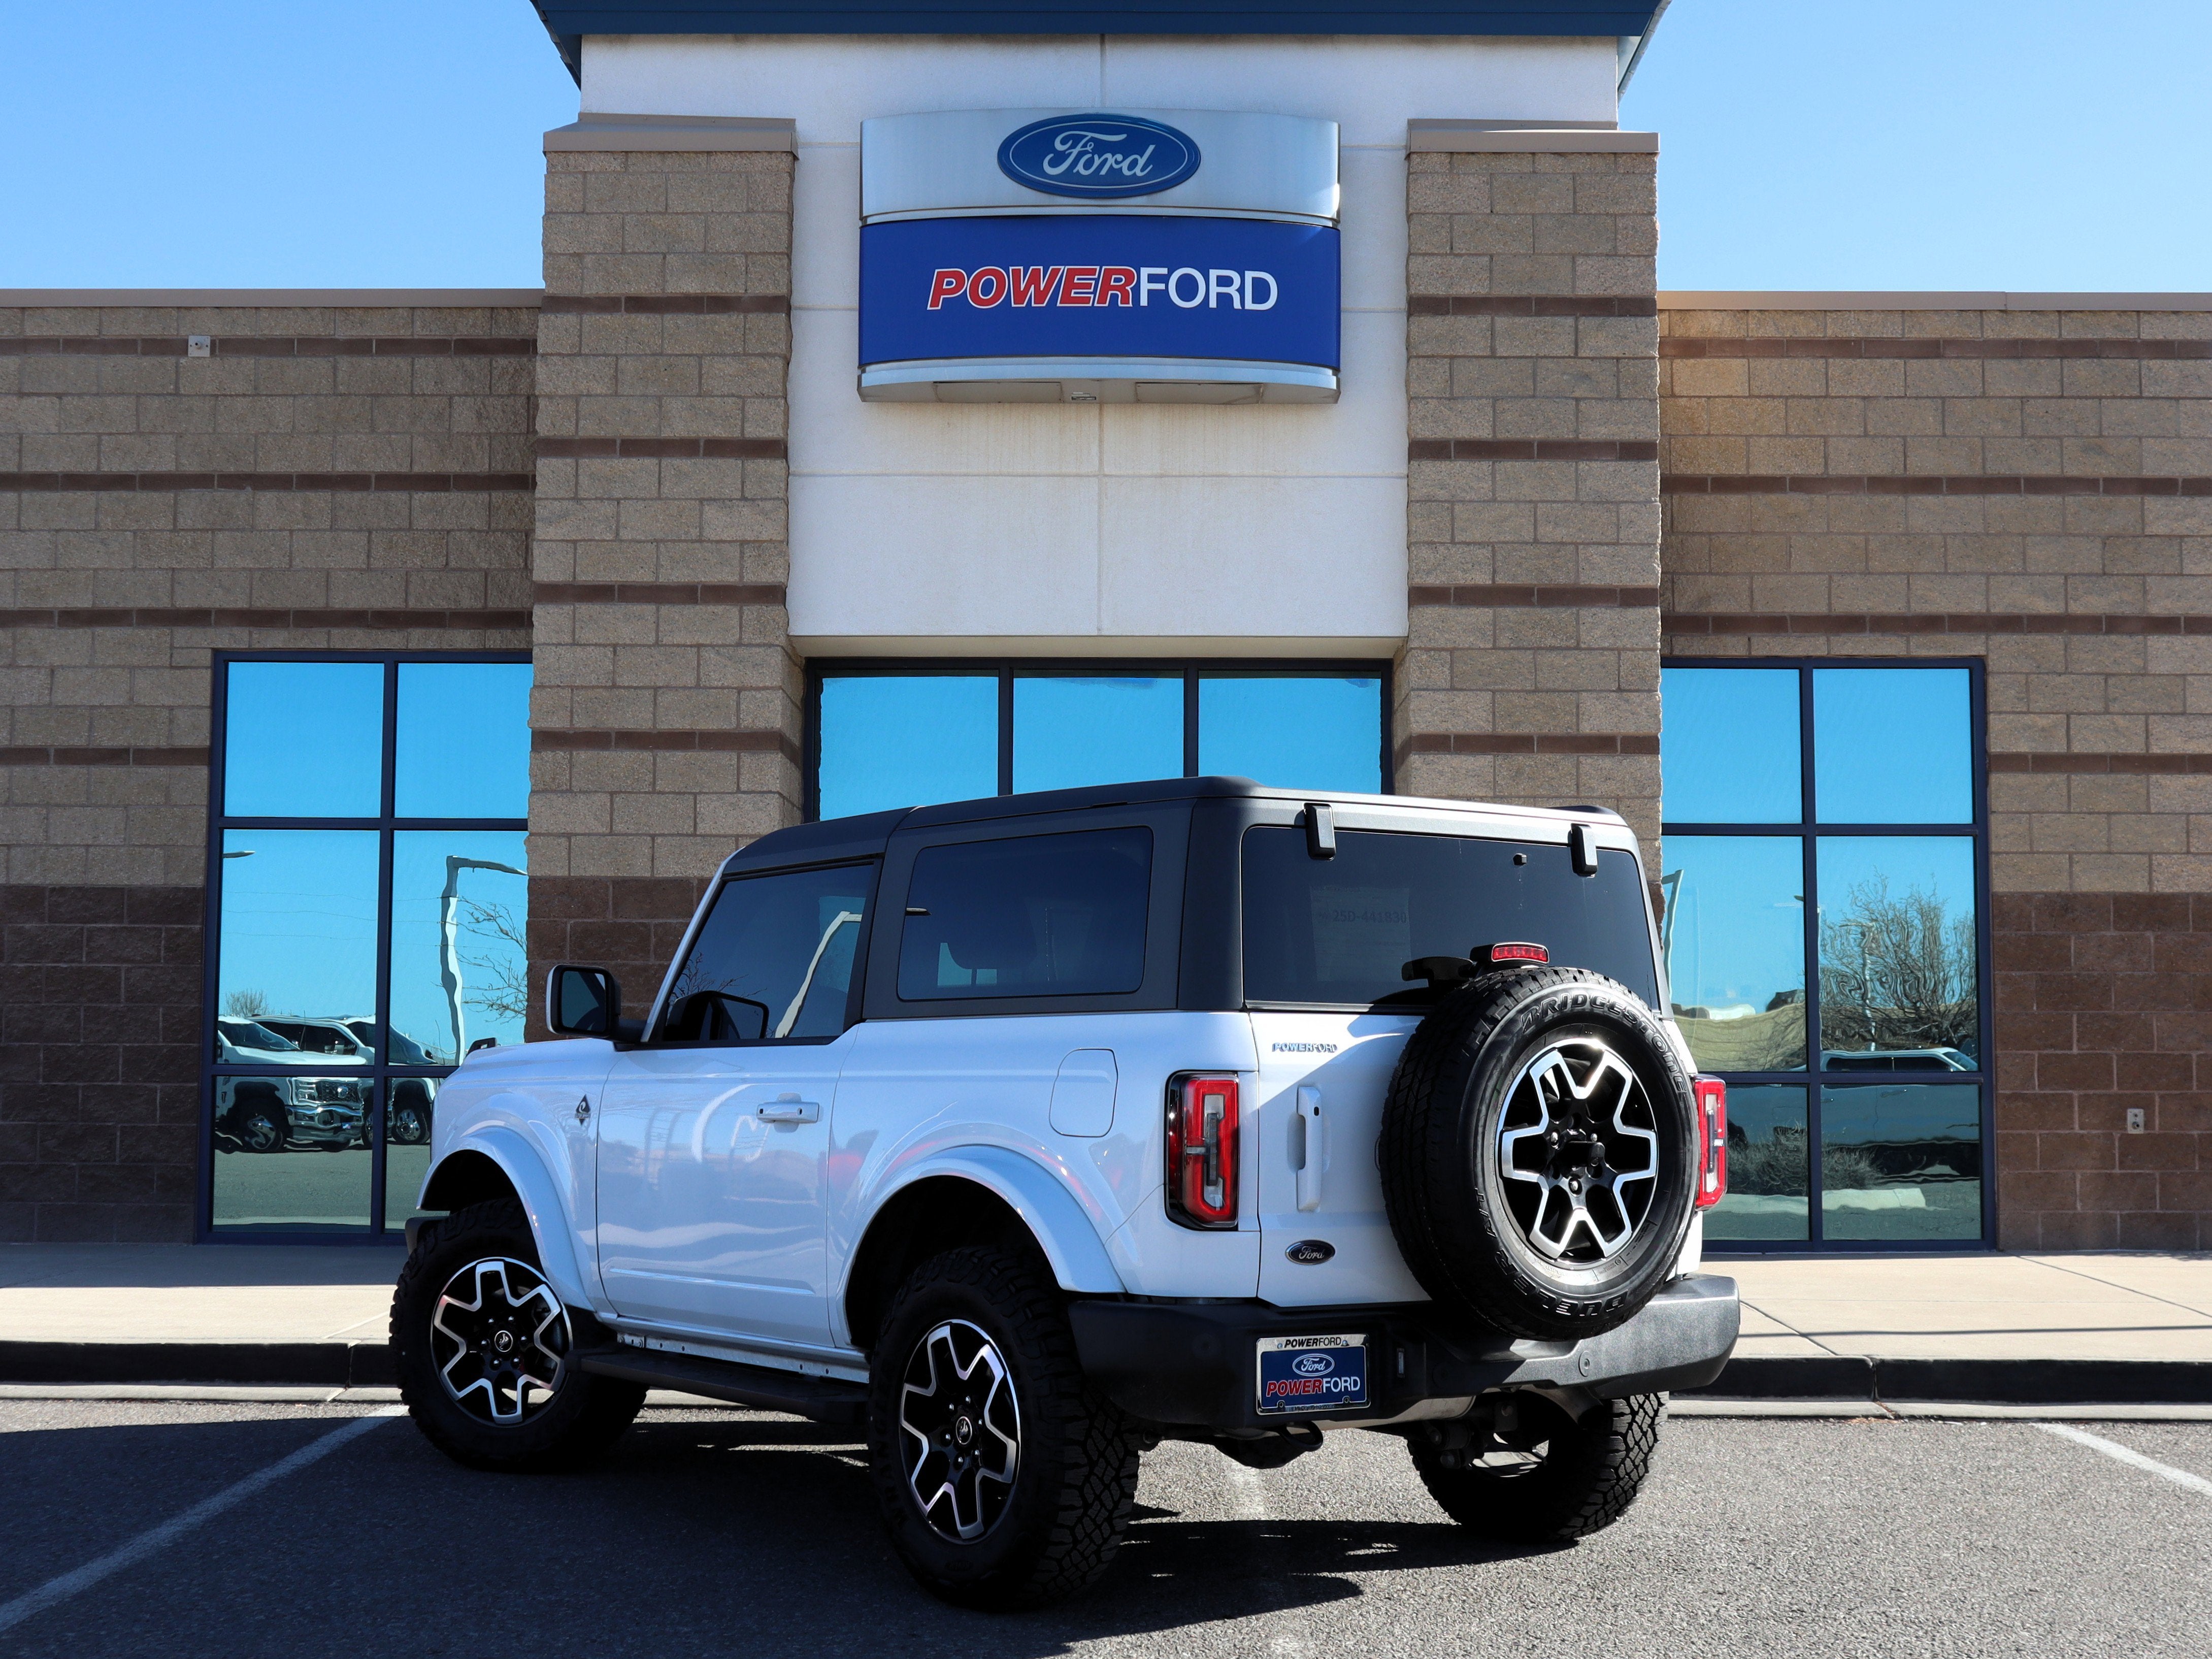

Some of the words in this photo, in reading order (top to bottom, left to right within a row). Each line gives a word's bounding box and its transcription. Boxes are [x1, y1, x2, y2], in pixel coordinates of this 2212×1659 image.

[1042, 130, 1156, 177] Ford
[926, 265, 1278, 311] POWERFORD
[1271, 1042, 1338, 1053] POWERFORD
[1519, 992, 1688, 1093] BRIDGESTONE
[1298, 1245, 1326, 1259] Ford
[1494, 1248, 1630, 1317] DUELER
[1284, 1337, 1342, 1348] POWERFORD
[1301, 1357, 1327, 1372] Ford
[1266, 1376, 1361, 1397] POWERFORD
